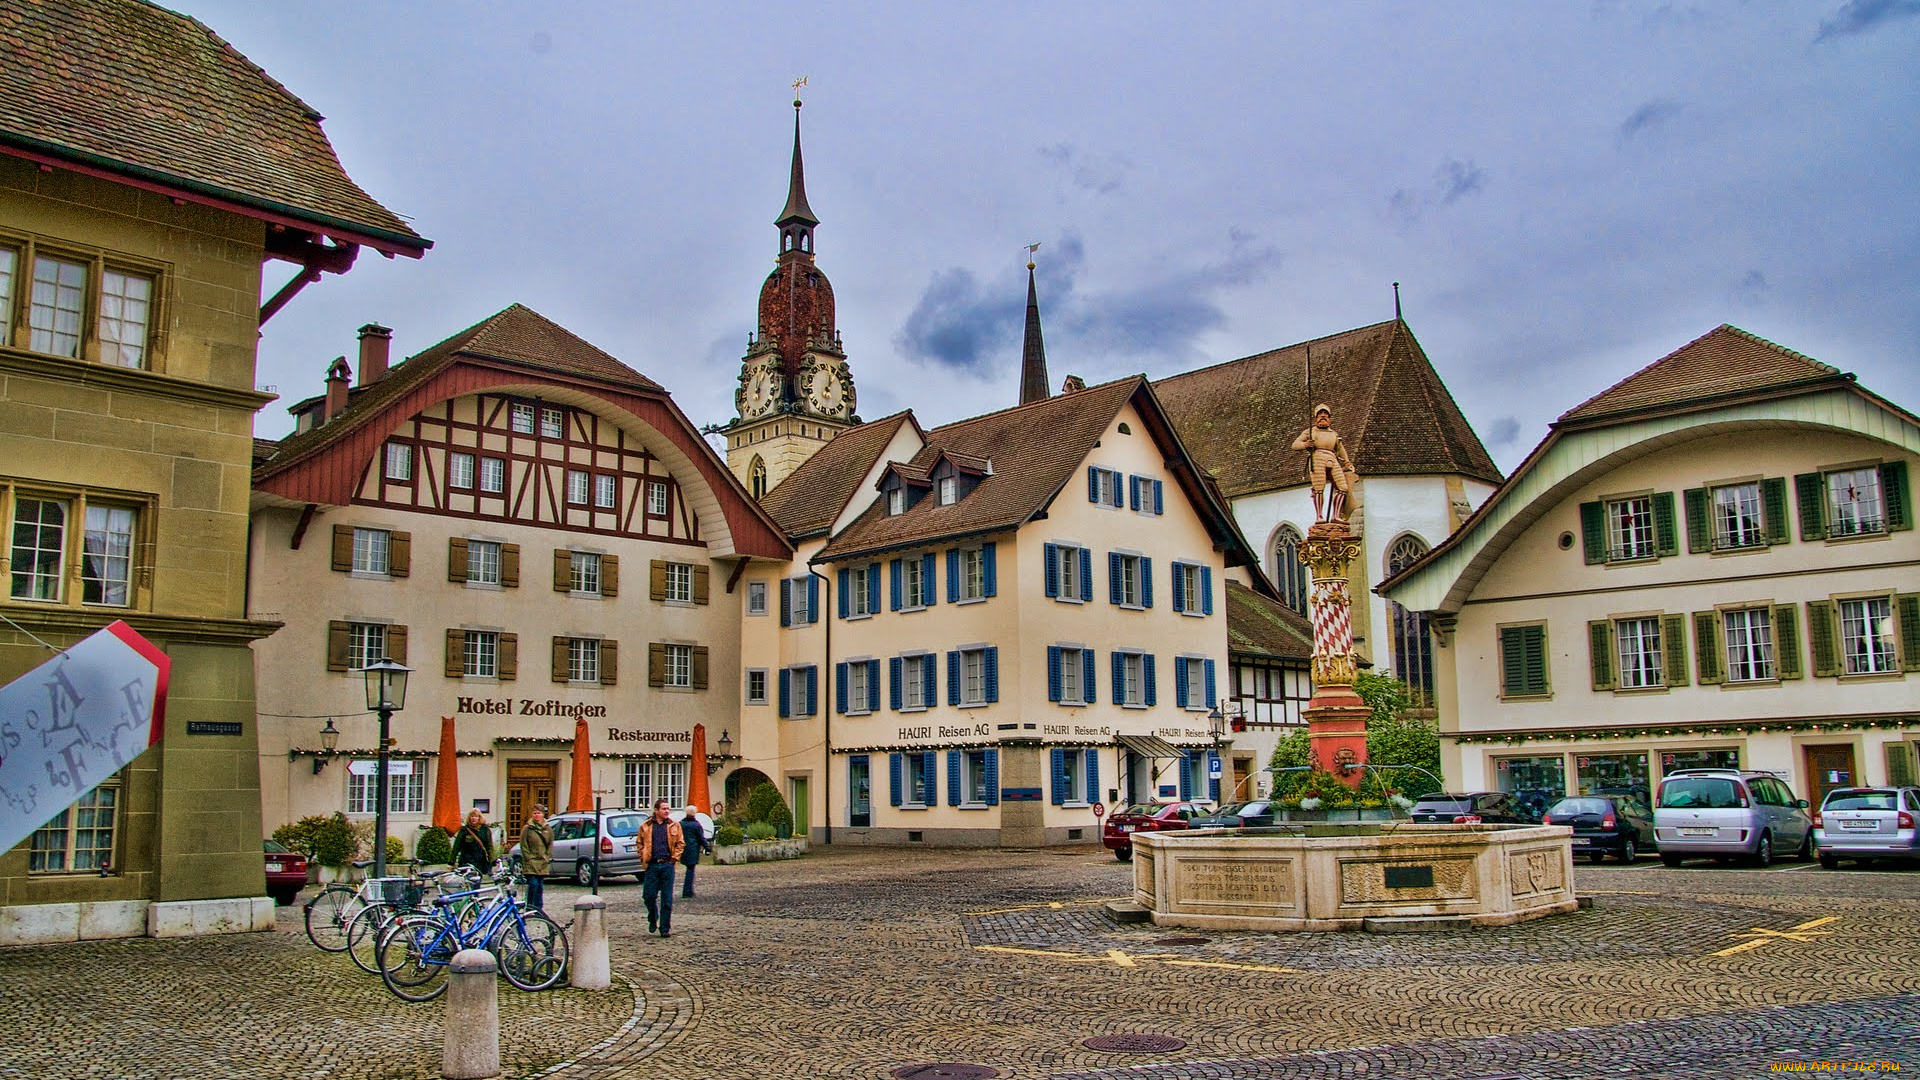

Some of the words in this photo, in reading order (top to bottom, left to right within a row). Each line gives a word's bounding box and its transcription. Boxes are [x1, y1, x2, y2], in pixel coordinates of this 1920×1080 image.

[457, 696, 513, 715] Hotel
[519, 699, 607, 721] Zofingen
[607, 727, 692, 743] Restaurant
[898, 727, 931, 740] HAURI
[938, 725, 971, 738] Reisen
[973, 723, 990, 736] AG
[1043, 725, 1070, 735] HAURI
[1074, 725, 1099, 736] Reisen
[1100, 726, 1111, 736] AG
[1159, 728, 1182, 737] HAURI
[1184, 728, 1206, 738] Reisen
[1212, 760, 1219, 771] P
